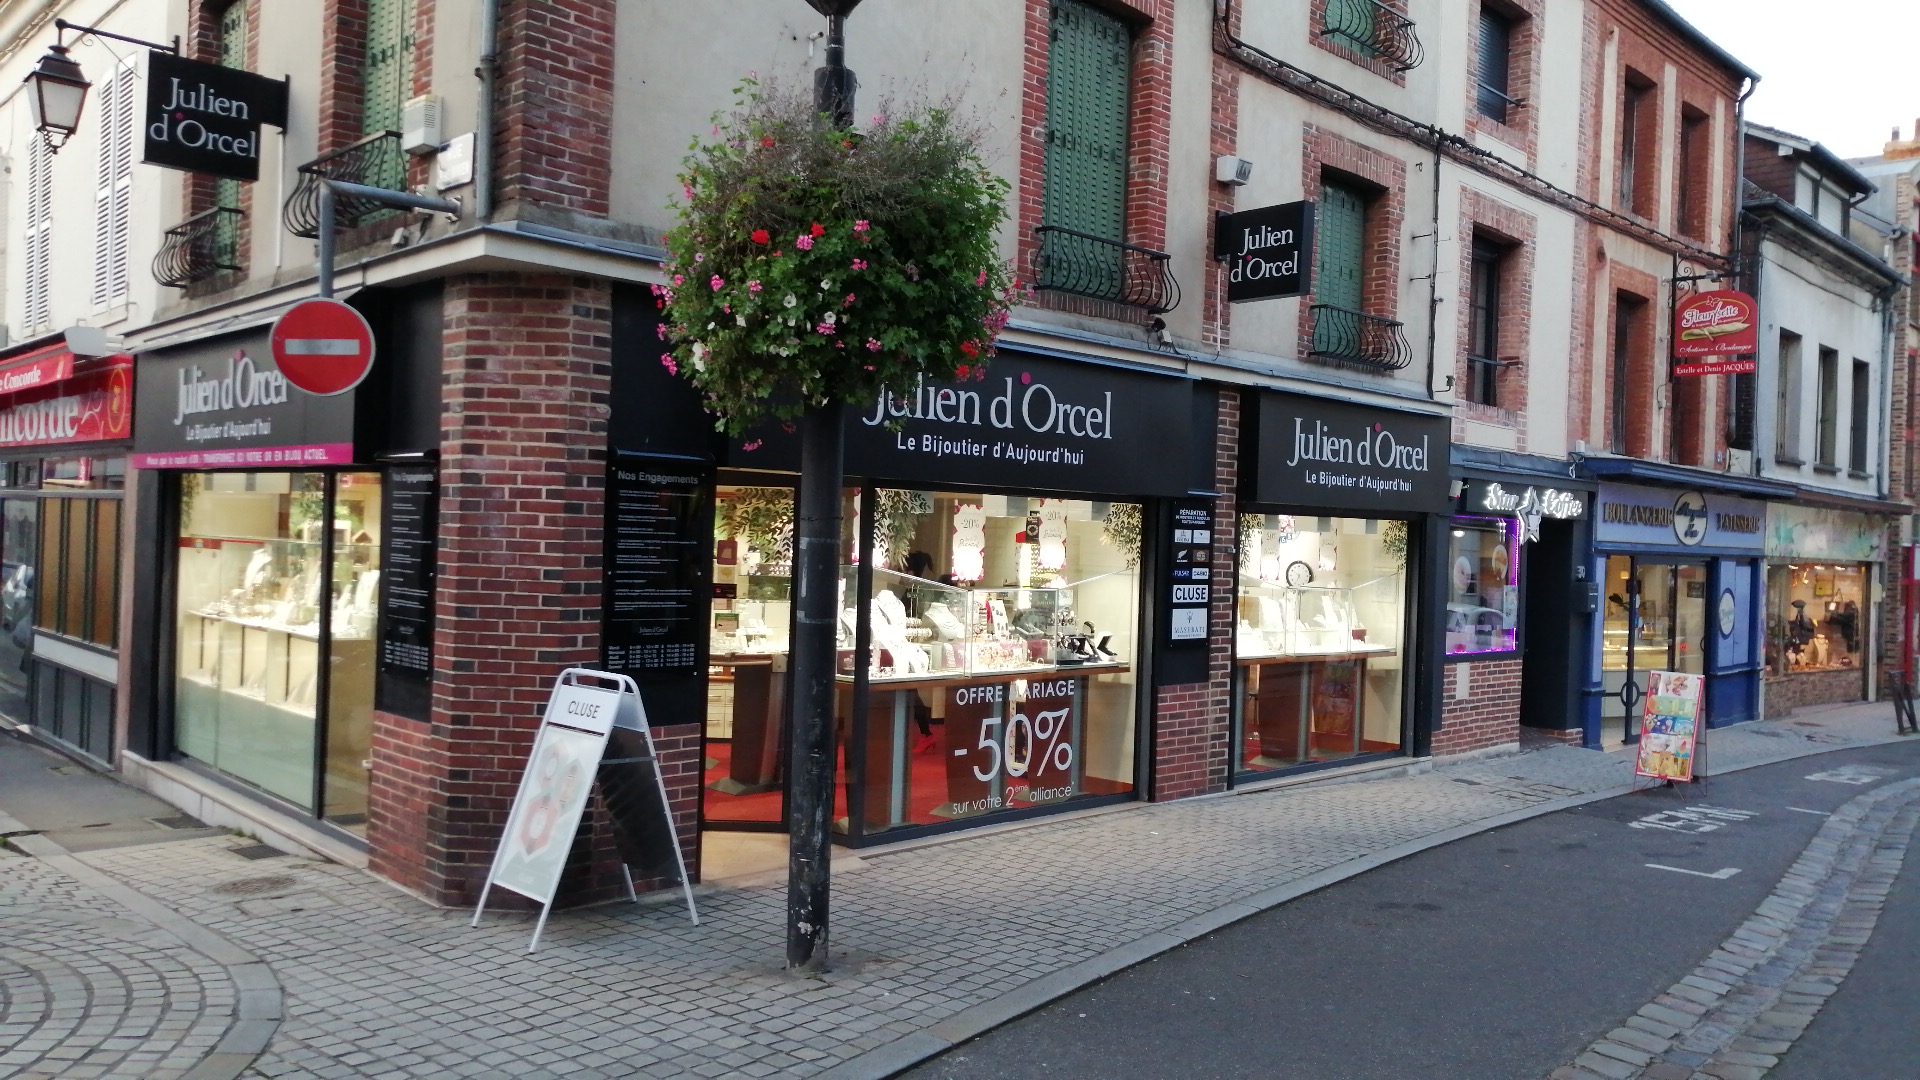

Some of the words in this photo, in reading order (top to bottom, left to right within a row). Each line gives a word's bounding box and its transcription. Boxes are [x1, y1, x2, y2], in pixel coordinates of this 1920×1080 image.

[162, 77, 248, 119] Julien
[150, 113, 256, 158] d'Orcel
[1238, 225, 1293, 256] Julien
[1230, 250, 1298, 283] d'Orcel
[4, 365, 41, 390] Concorde
[1704, 365, 1721, 373] Denis
[1723, 361, 1755, 372] JACQUES
[173, 365, 219, 425] Julien
[862, 371, 982, 426] Julien
[990, 372, 1113, 439] d'Orcel
[897, 431, 916, 450] Le
[923, 434, 987, 457] Bijoutier
[993, 442, 1085, 465] d'Aujourd'hui
[1287, 417, 1353, 467] Julien
[1357, 422, 1428, 472] d'Orcel
[618, 470, 636, 480] Nos
[639, 471, 699, 485] Engagements
[1306, 470, 1316, 484] Le
[1320, 471, 1357, 488] Bijoutier
[1359, 475, 1412, 492] d'Aujourd'hui
[1603, 502, 1675, 528] BOULANGERIE
[1175, 587, 1206, 601] CLUSE
[568, 700, 601, 719] CLUSE
[956, 685, 1003, 706] OFFRE
[954, 707, 1073, 782] -50%
[952, 800, 970, 815] sur
[972, 794, 1002, 811] votre
